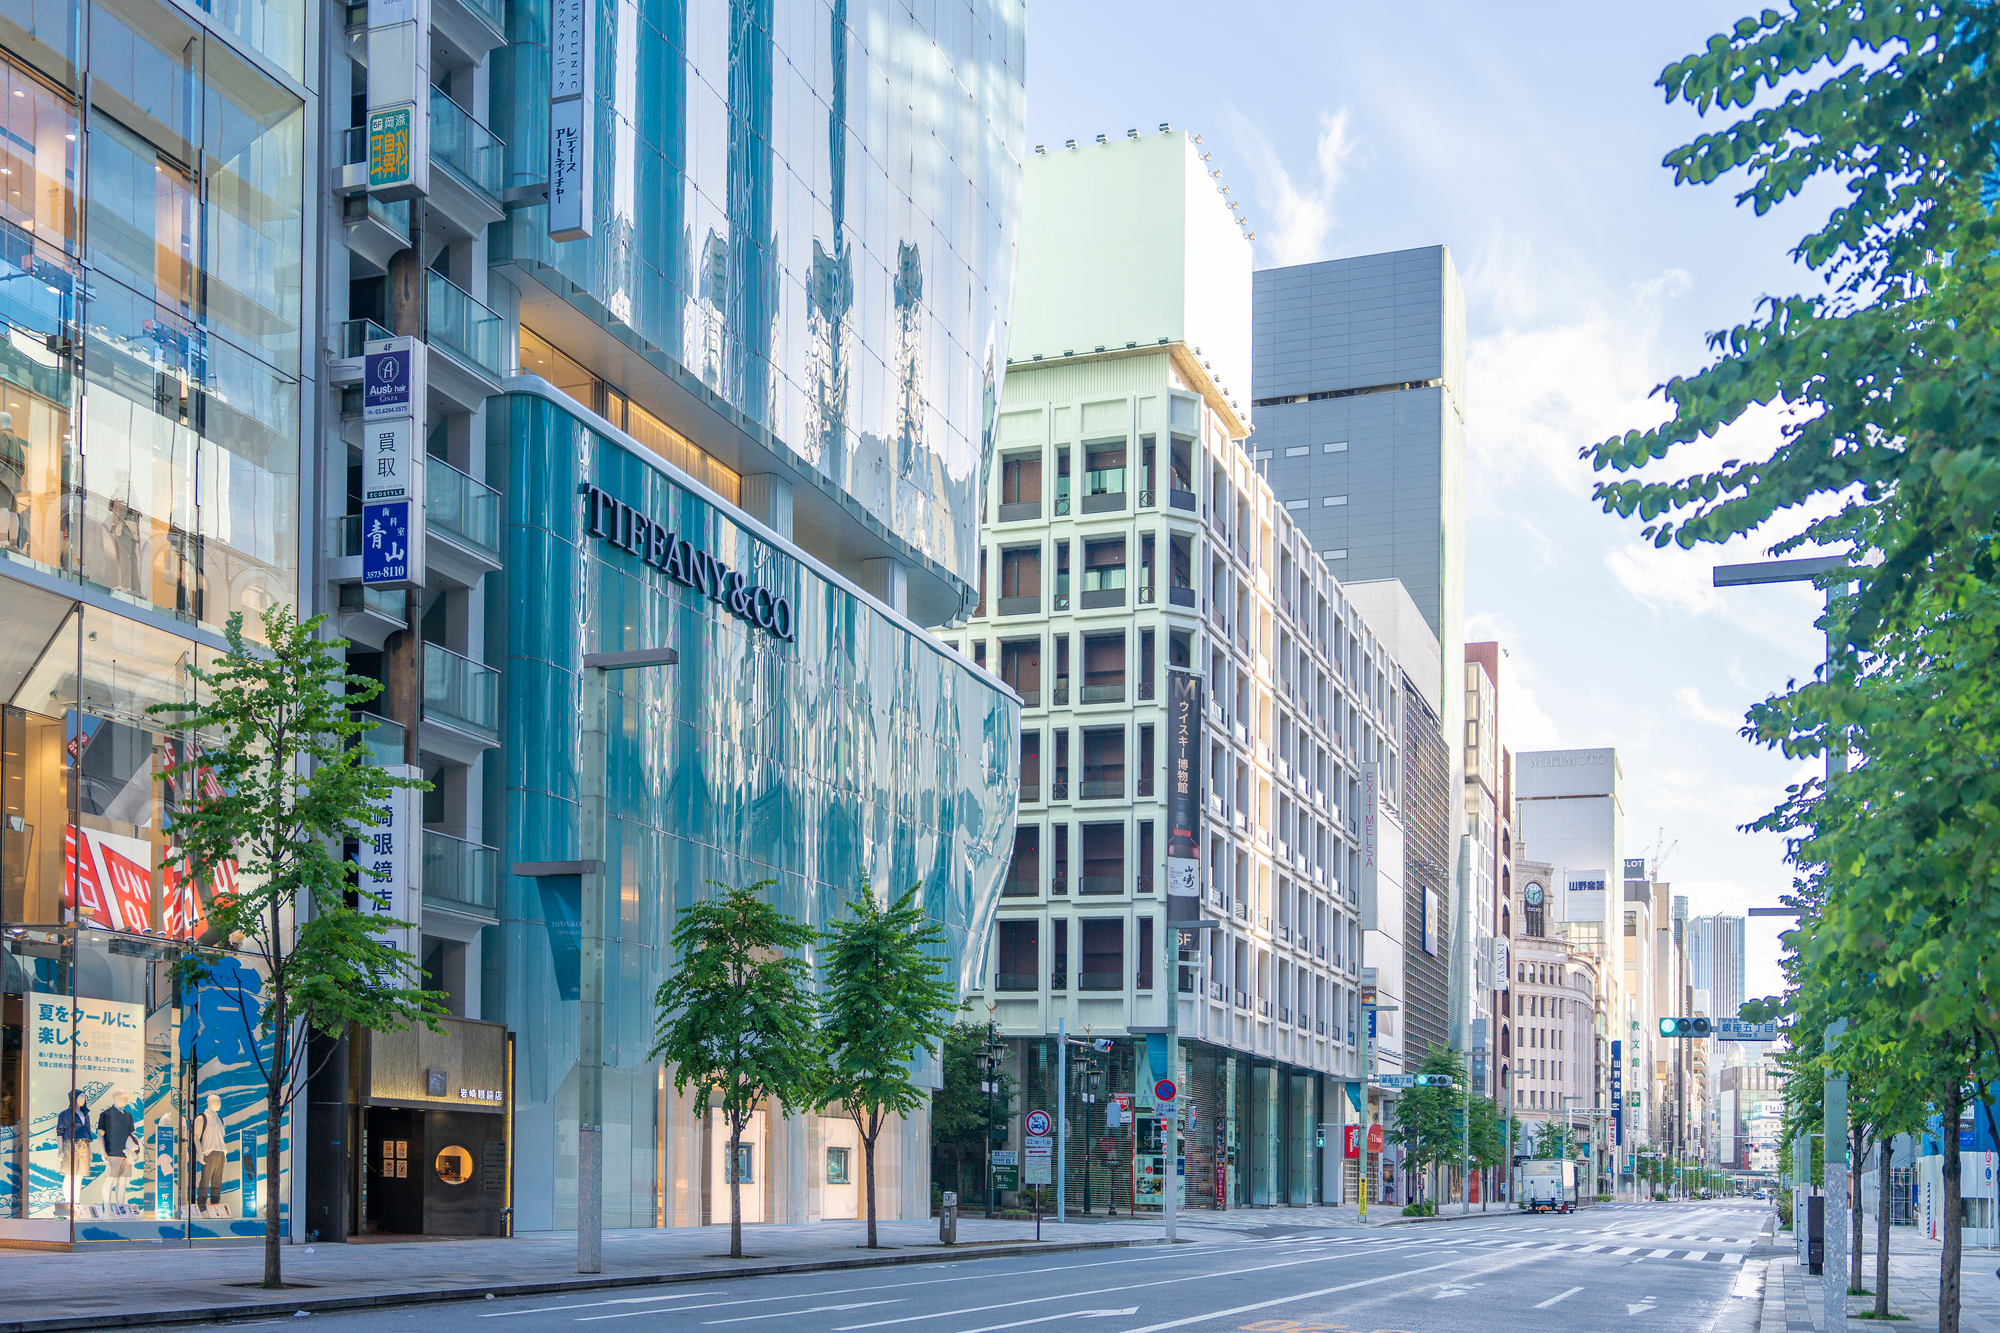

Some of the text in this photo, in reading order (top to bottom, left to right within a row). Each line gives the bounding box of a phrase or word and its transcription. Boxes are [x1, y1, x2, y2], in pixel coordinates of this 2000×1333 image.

[570, 30, 579, 89] CLINIC
[370, 128, 408, 179] 耳鼻科
[566, 127, 577, 173] レディース
[555, 128, 566, 204] アートネイチャー
[383, 343, 392, 351] 4F
[369, 383, 407, 396] Aust hair
[377, 431, 396, 478] 買取
[369, 489, 403, 498] ECOSTYLE
[366, 518, 405, 563] 青山
[366, 565, 405, 580] 3573-8110
[1173, 676, 1196, 701] M
[1177, 700, 1189, 795] ウイスキー博物館
[1531, 754, 1607, 769] MIKIMOTO
[371, 785, 394, 912] 崎眼鏡店
[1427, 906, 1437, 938] GU
[1497, 943, 1505, 985] TASAKI
[38, 1003, 137, 1029] 夏をクールに、
[1721, 1023, 1774, 1033] 銀座五丁目
[38, 1026, 89, 1048] 楽しく。
[1631, 1020, 1640, 1068] 教文館
[459, 1087, 503, 1101] 岩崎眼鏡店
[1632, 1093, 1640, 1105] 本
